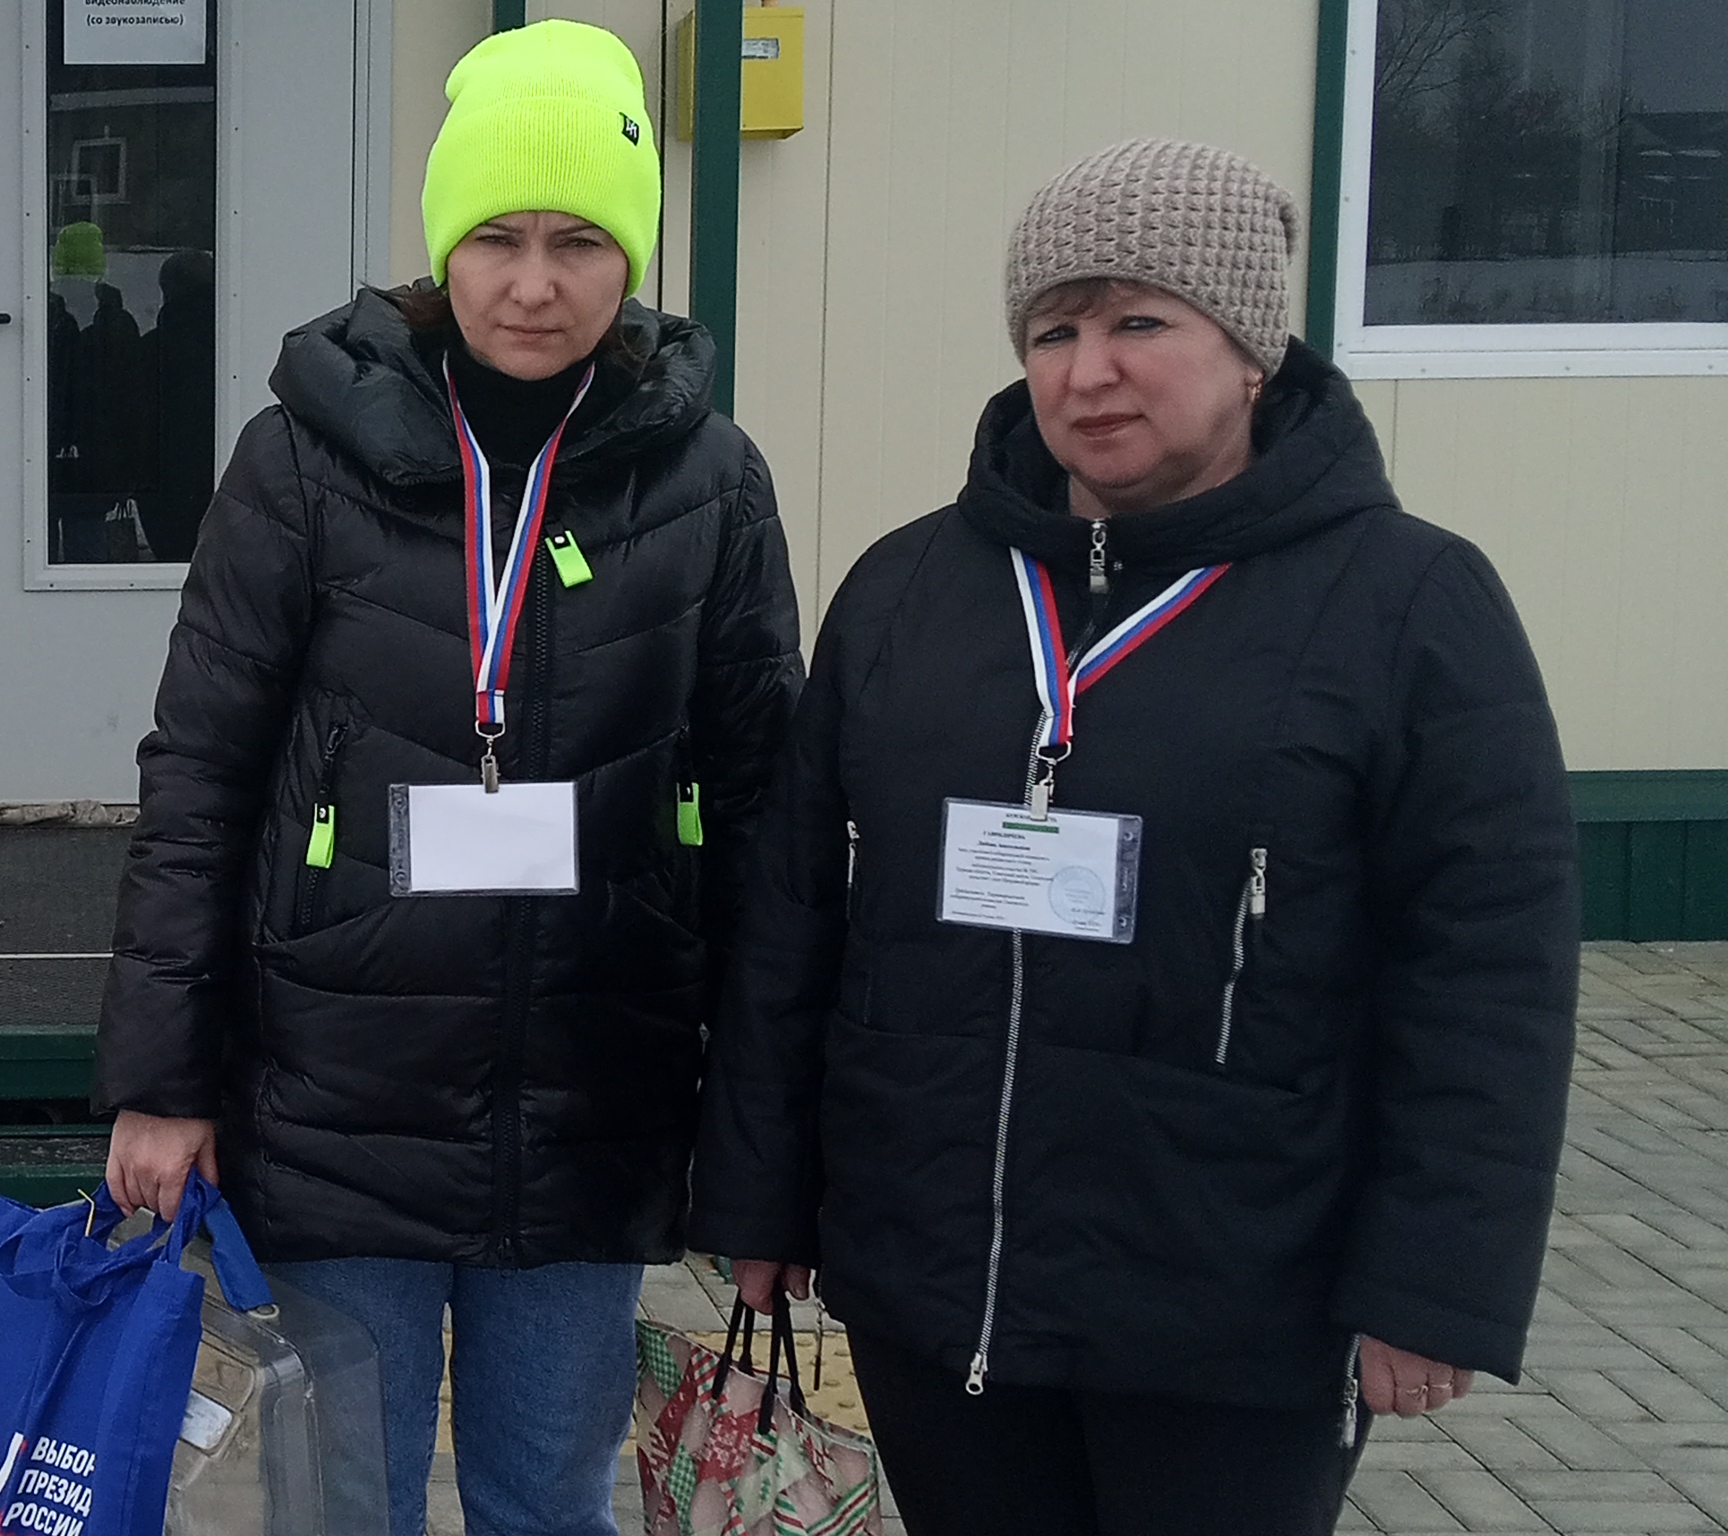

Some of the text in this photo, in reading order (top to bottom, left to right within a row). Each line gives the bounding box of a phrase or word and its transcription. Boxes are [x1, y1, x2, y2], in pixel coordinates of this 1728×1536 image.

[86, 13, 184, 26] (со звукозаписью)
[17, 1468, 93, 1517] ПРЕЗИД
